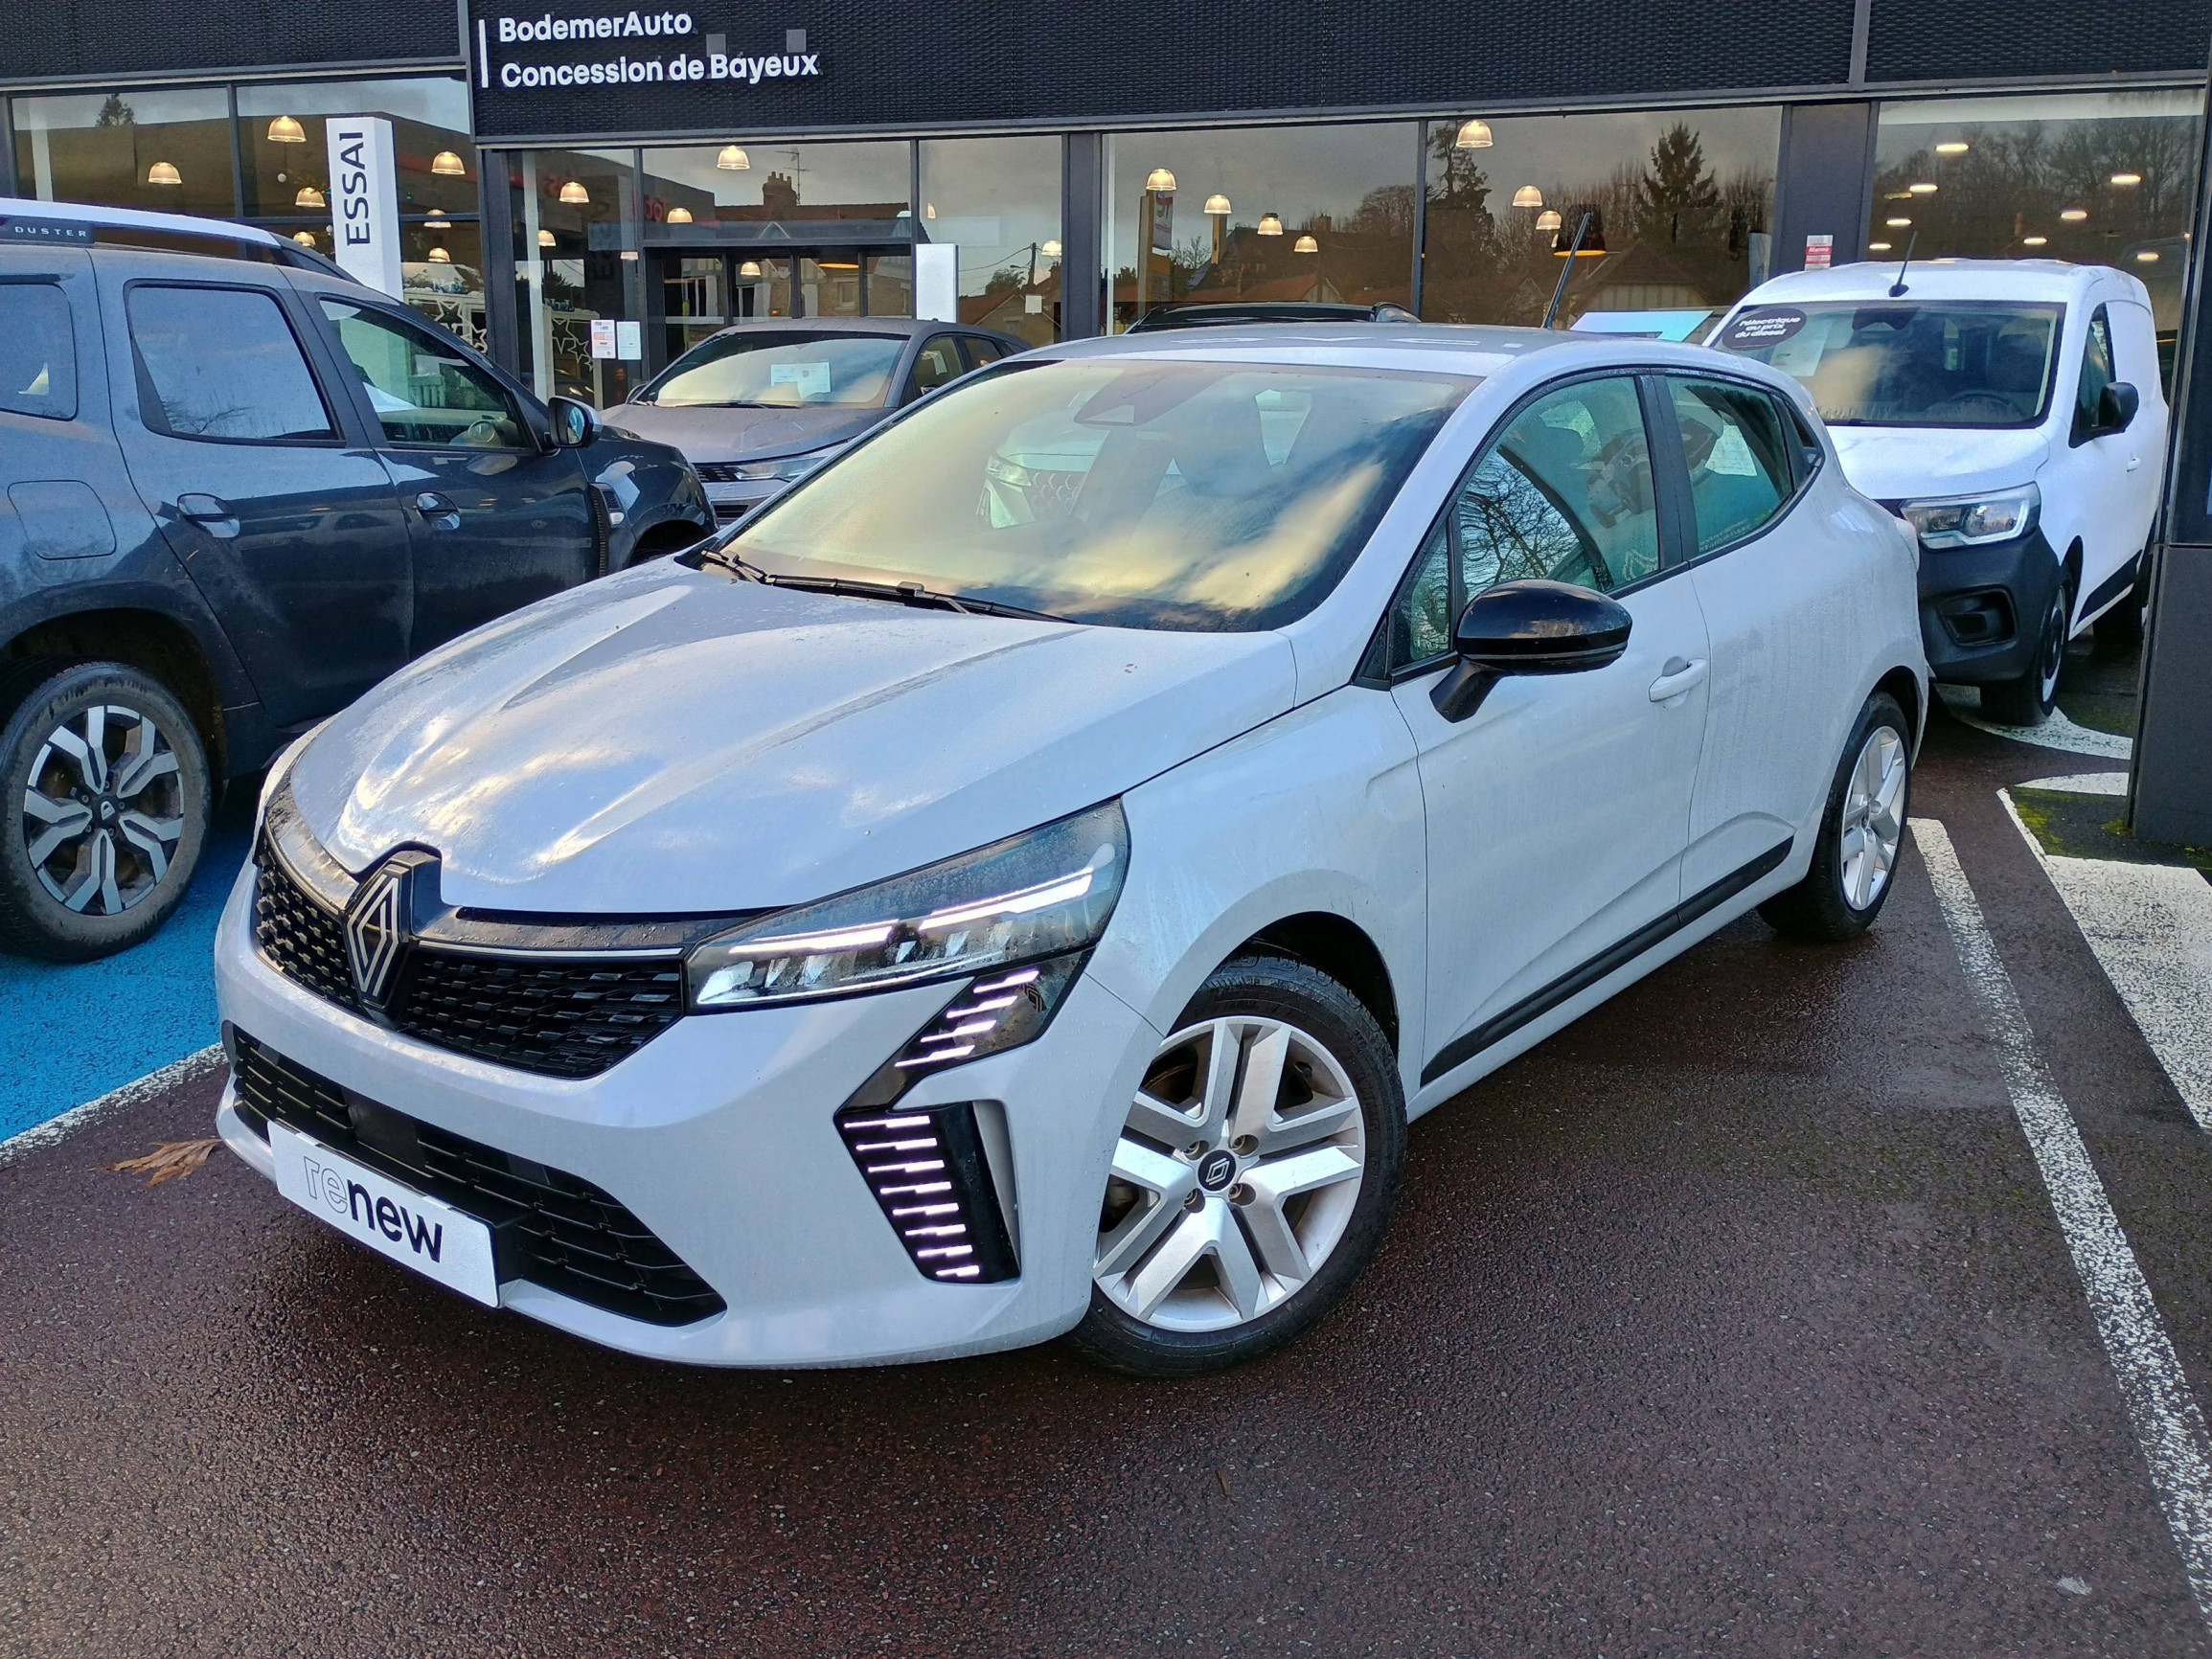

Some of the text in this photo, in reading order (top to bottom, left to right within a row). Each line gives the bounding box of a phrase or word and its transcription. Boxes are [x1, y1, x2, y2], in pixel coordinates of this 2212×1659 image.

[499, 11, 693, 42] BodemerAuto
[500, 53, 819, 88] Concession de Bayeux
[338, 131, 371, 247] ESSAI
[14, 225, 87, 238] DUSTER
[1734, 328, 1788, 339] du diesel
[1761, 322, 1786, 331] prix
[303, 1155, 444, 1264] renew
